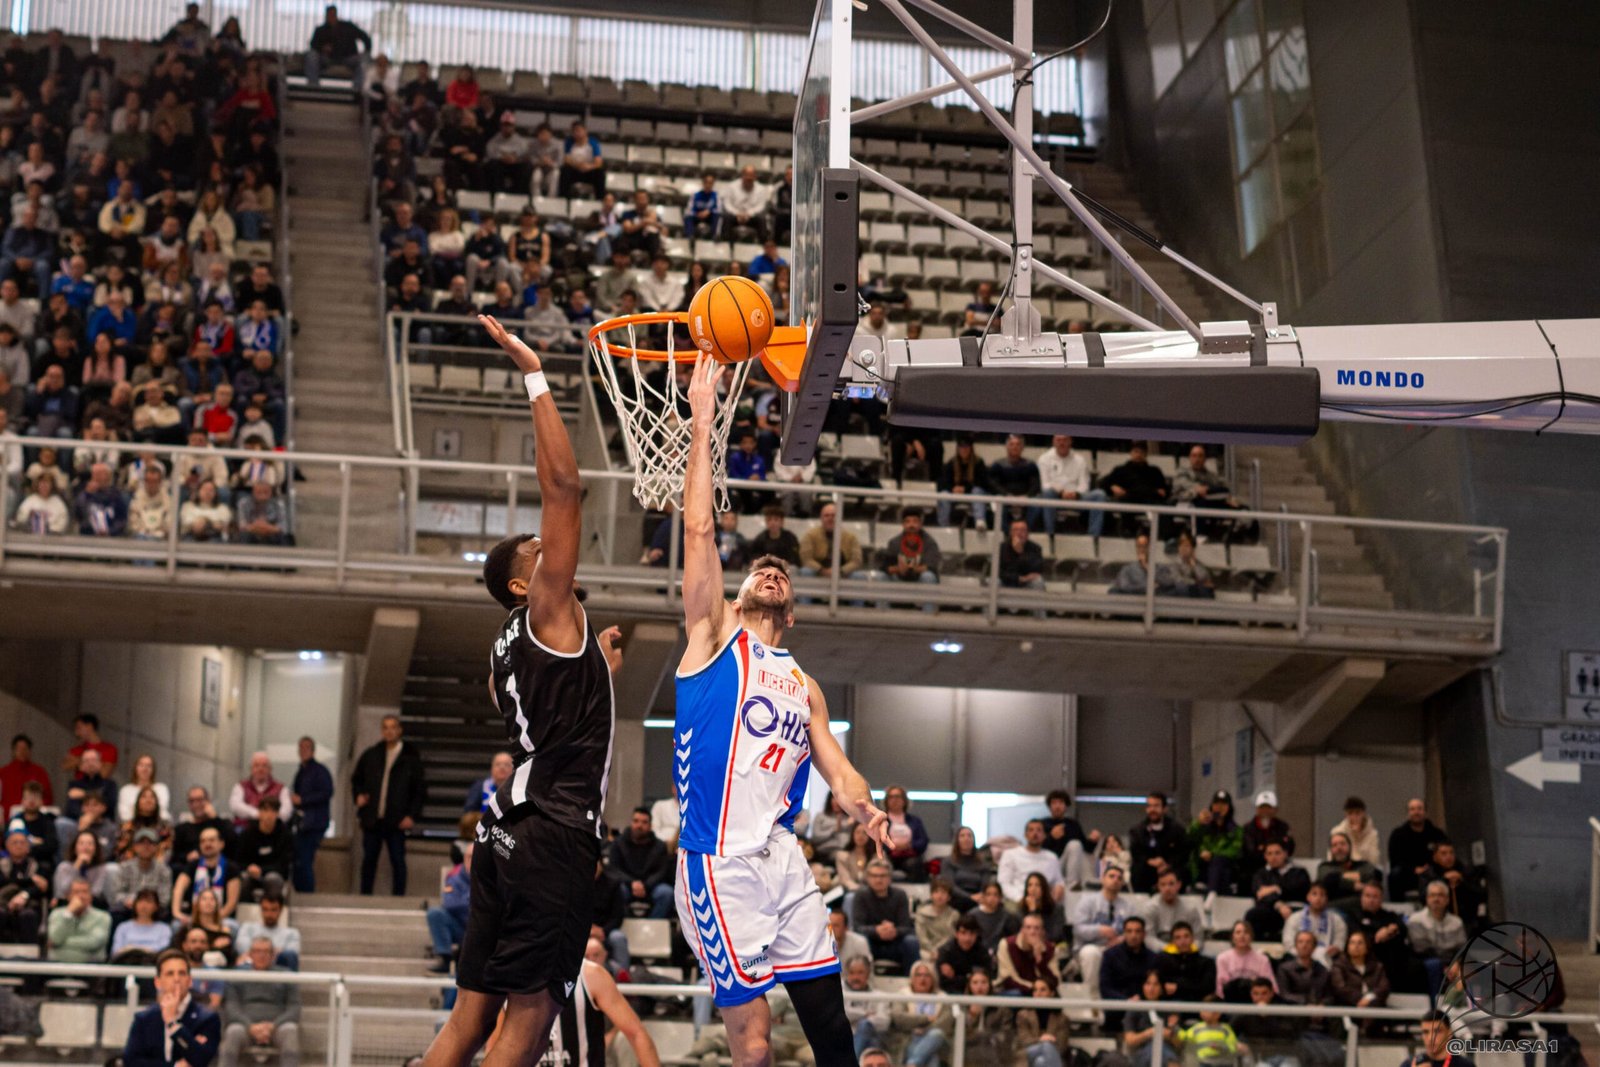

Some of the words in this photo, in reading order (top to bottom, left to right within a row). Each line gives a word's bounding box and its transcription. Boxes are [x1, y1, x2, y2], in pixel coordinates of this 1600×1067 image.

[1336, 369, 1425, 389] MONDO
[758, 669, 811, 707] LUCENT
[759, 743, 787, 773] 21
